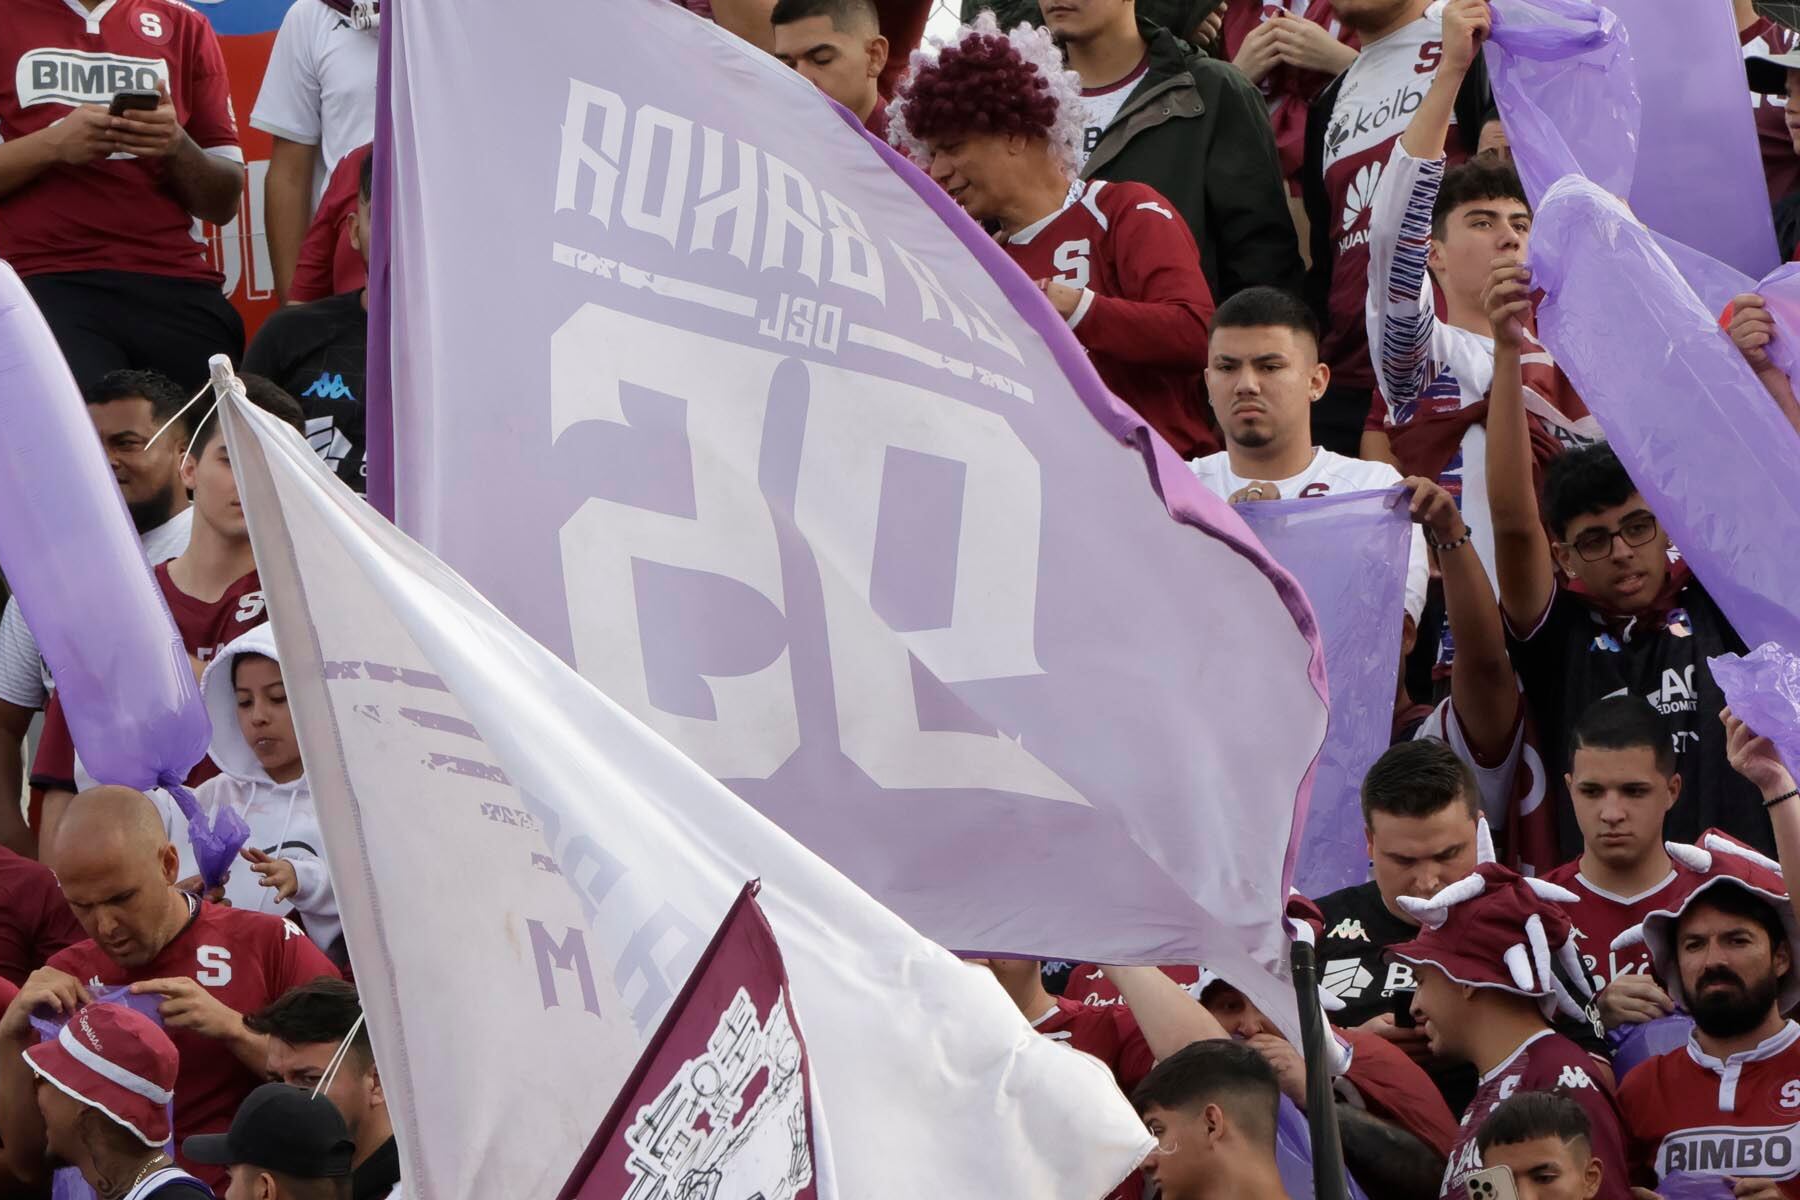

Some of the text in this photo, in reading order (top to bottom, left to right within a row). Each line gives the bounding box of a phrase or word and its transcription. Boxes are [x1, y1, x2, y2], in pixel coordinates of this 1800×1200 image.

[139, 12, 163, 38] S
[1414, 41, 1442, 73] S
[32, 59, 158, 97] BIMBO
[1353, 79, 1434, 134] kölb
[1052, 239, 1091, 291] S
[236, 592, 265, 622] S
[196, 945, 231, 986] S
[1664, 1136, 1792, 1173] BIMBO
